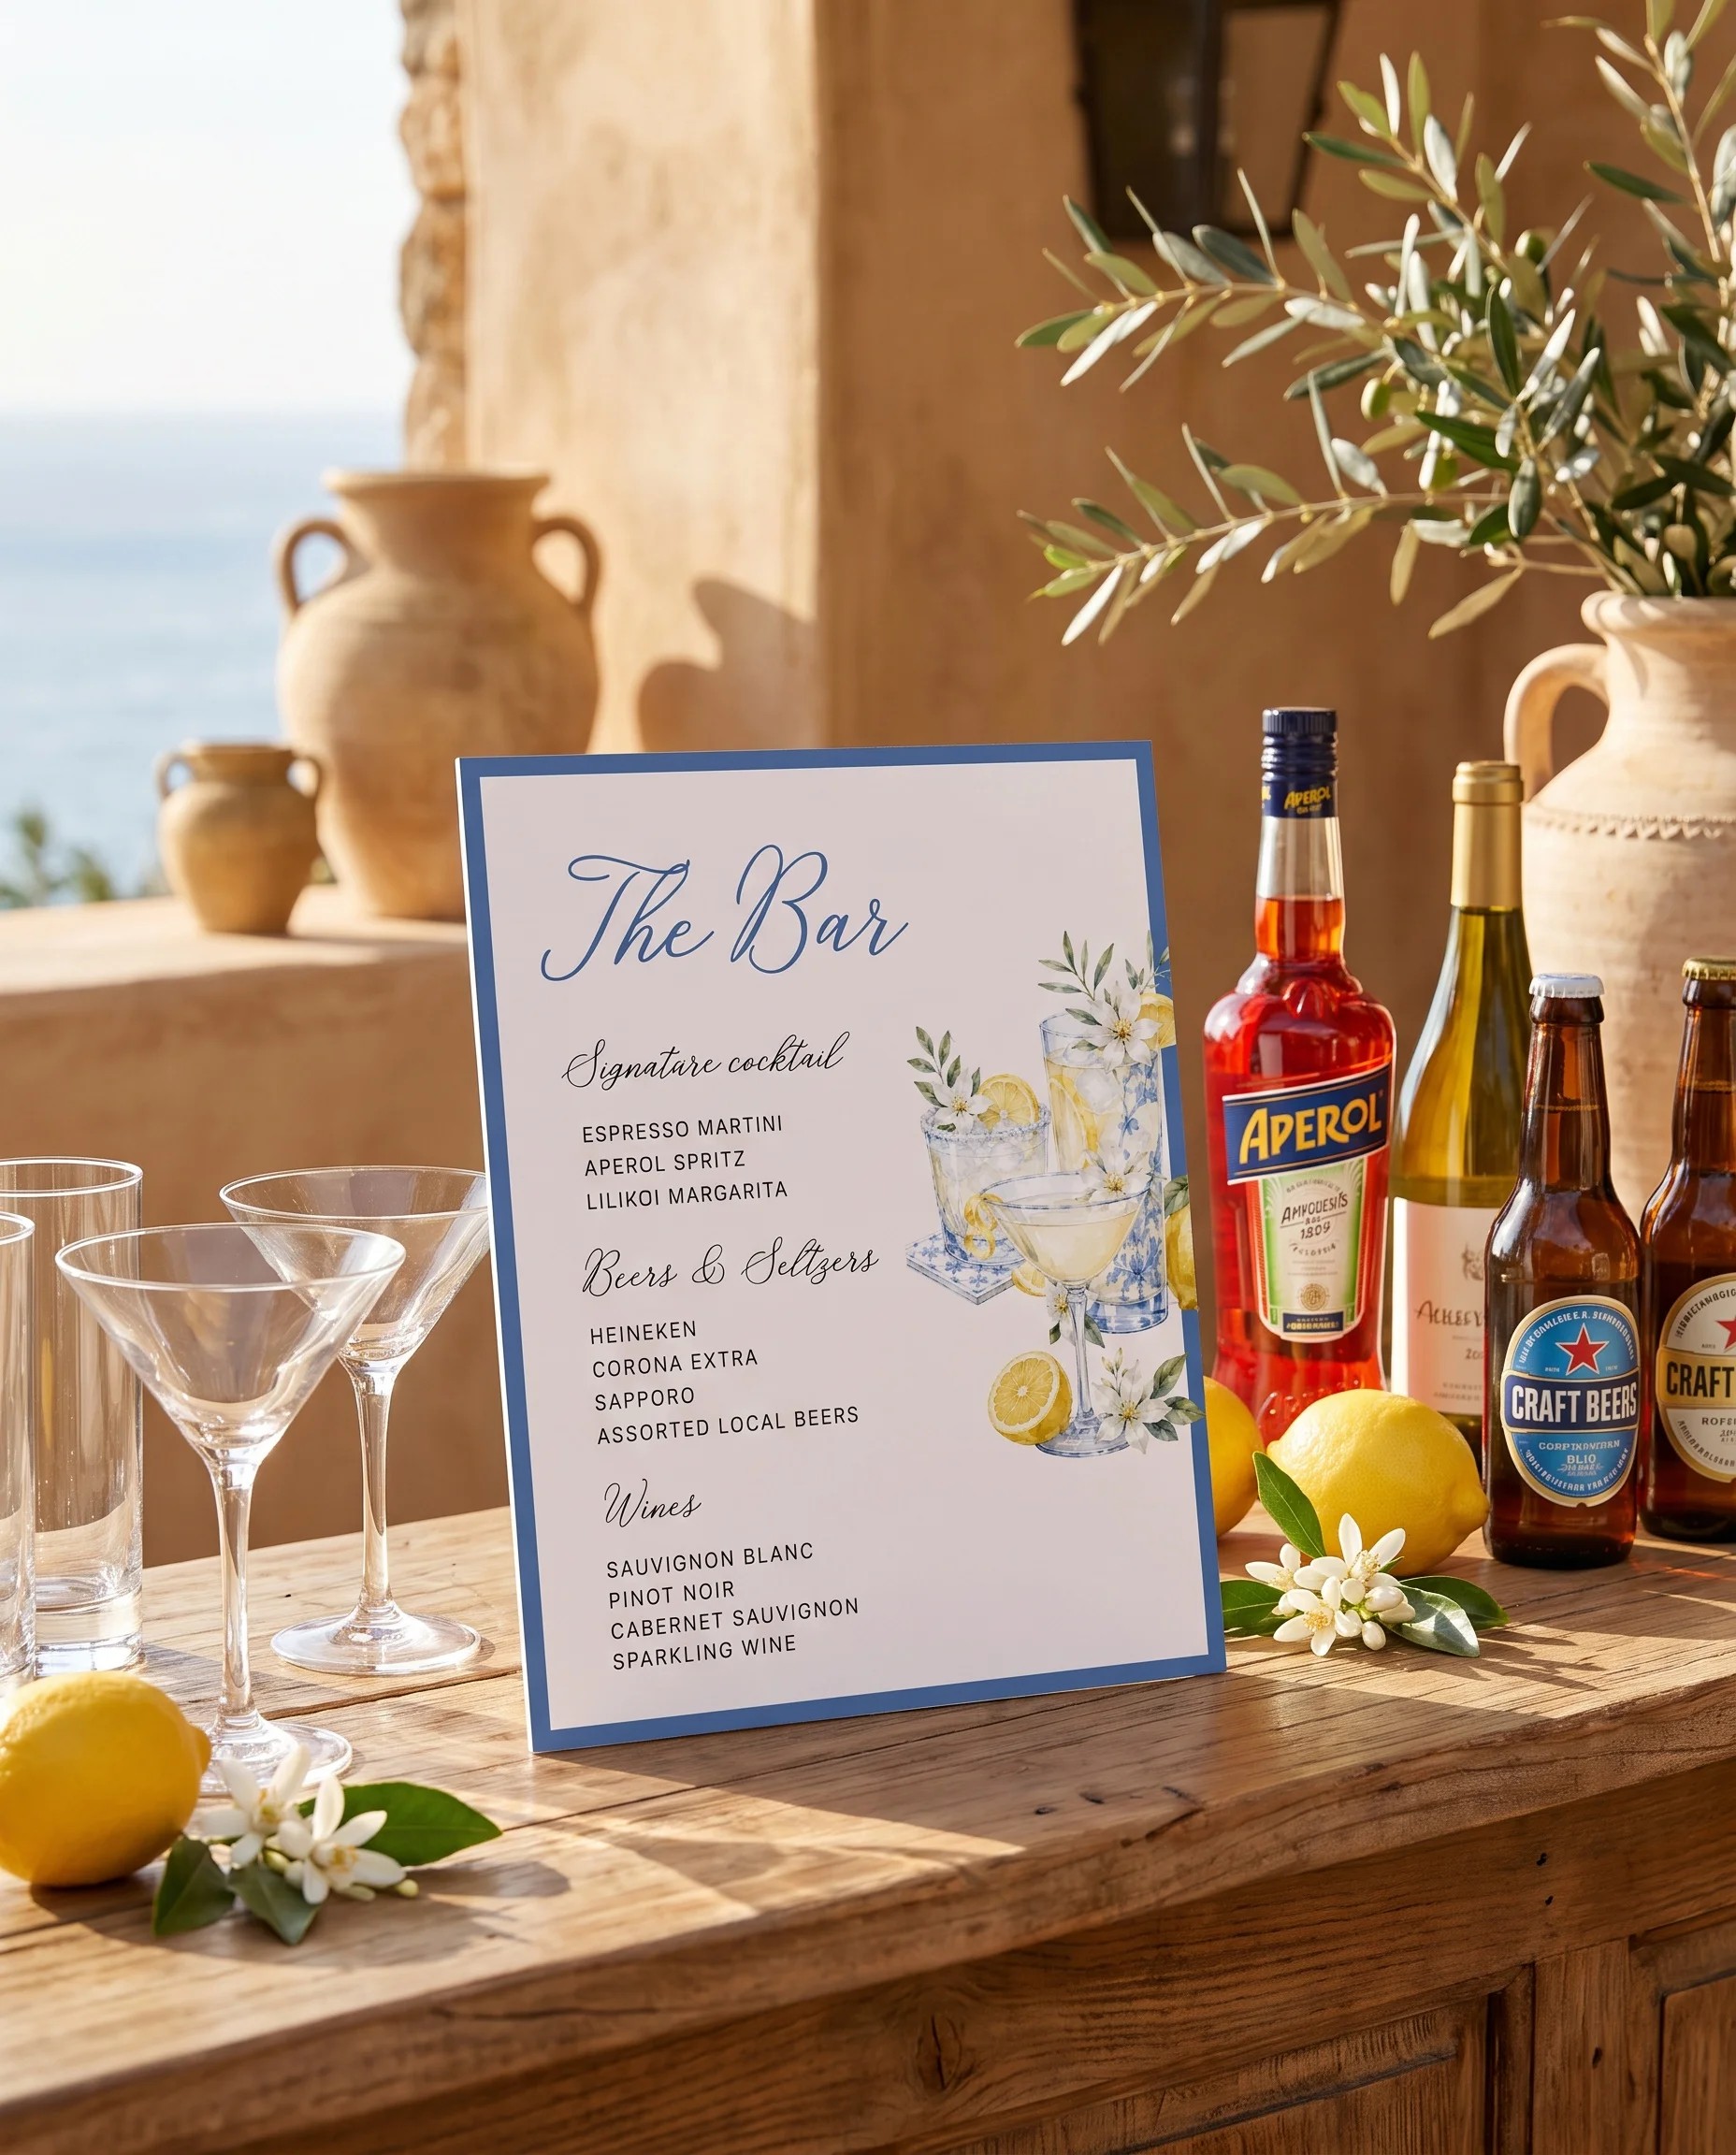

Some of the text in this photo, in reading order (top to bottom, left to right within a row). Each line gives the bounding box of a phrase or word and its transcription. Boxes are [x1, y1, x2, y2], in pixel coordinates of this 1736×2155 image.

[1284, 787, 1331, 810] APEROL
[541, 844, 909, 982] The Bar
[560, 1031, 850, 1092] Signature cocktail
[582, 1114, 782, 1144] ESPRESSO MARTINI
[1238, 1092, 1382, 1165] APEROL
[585, 1150, 745, 1177] APEROL SPRITZ
[586, 1180, 788, 1210] LILIKOI MARGARITA
[582, 1236, 880, 1297] Beers & Seltzers
[590, 1320, 696, 1345] HEINEKEN
[592, 1349, 759, 1379] CORONA EXTRA
[1666, 1361, 1735, 1398] CRAFT
[595, 1386, 695, 1411] SAPPORO
[1512, 1381, 1637, 1424] CRAFT BEERS
[597, 1406, 859, 1445] ASSORTED LOCAL BEERS
[603, 1478, 702, 1528] Wines
[606, 1541, 813, 1579] SAUVIGNON BLANC
[609, 1580, 735, 1610] PINOT NOIR
[611, 1597, 859, 1640] CABERNET SAUVIGNON
[613, 1634, 796, 1670] SPARKLING WINE
